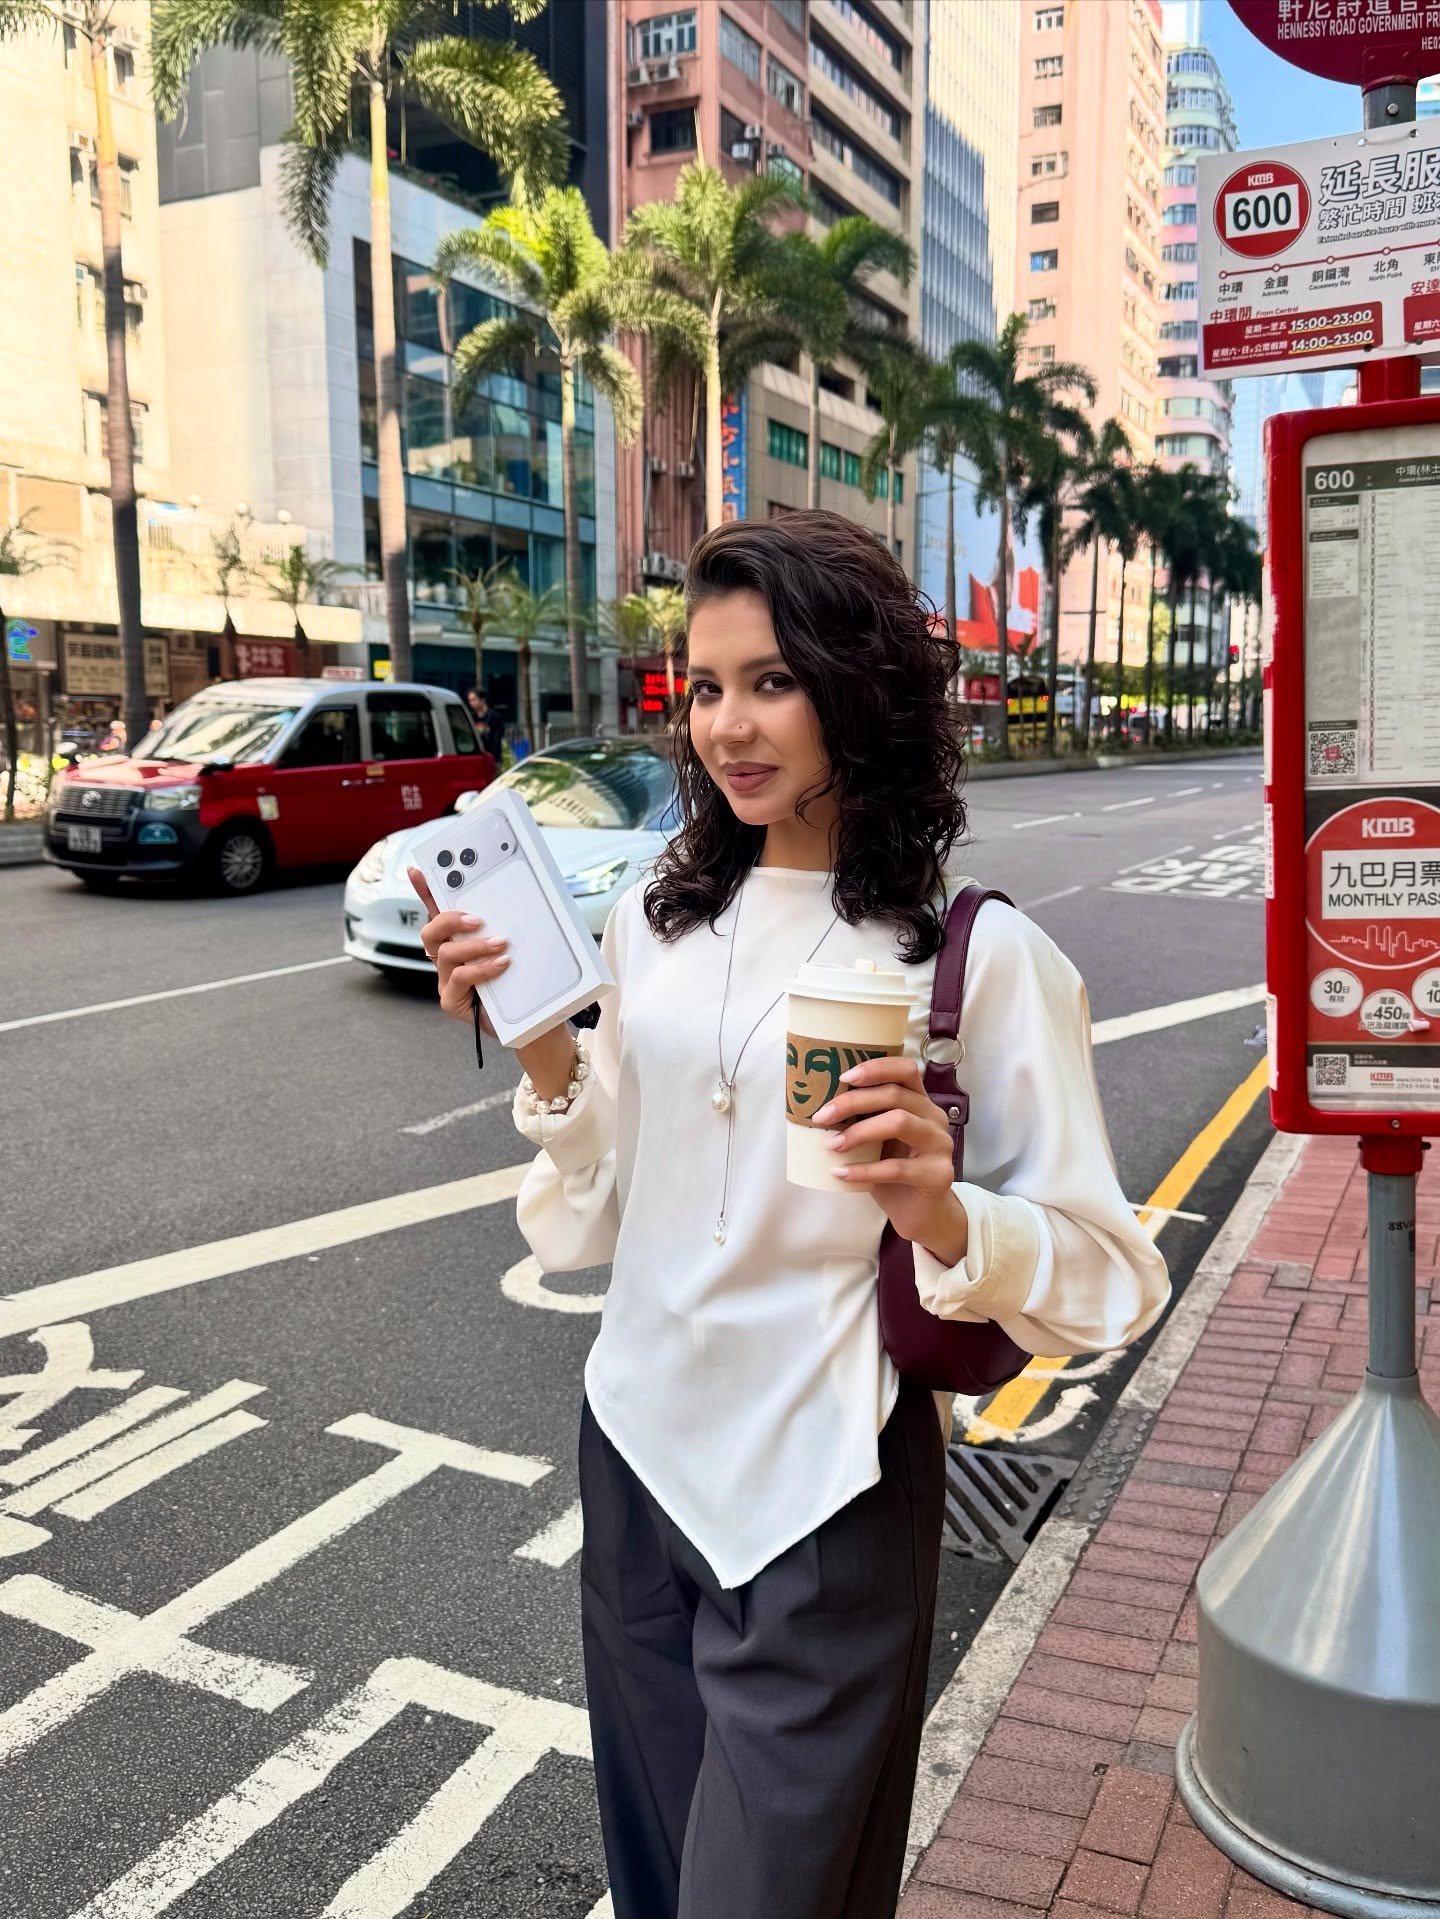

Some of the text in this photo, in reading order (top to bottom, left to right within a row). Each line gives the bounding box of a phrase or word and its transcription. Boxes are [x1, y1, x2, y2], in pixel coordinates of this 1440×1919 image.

[1278, 0, 1440, 22] 軒尼詩道
[1278, 11, 1440, 40] HENNESSY ROAD GOVERNMENT PR
[1247, 172, 1274, 187] KMB
[1319, 146, 1440, 206] 延長服
[1233, 191, 1291, 231] 600
[1318, 196, 1406, 230] 繁忙時間
[1373, 258, 1399, 274] 北角
[1219, 281, 1243, 295] 中環
[1264, 275, 1289, 290] 金鐘
[1256, 306, 1299, 318] From Central
[1290, 309, 1372, 332] 15:00-23:00
[1291, 330, 1373, 352] 14:00-23:00
[1314, 470, 1354, 490] 600
[1362, 817, 1415, 838] KMB
[1329, 861, 1440, 888] 九巴月票
[1328, 892, 1440, 907] MONTHLY PAS
[1370, 1072, 1393, 1081] KMB
